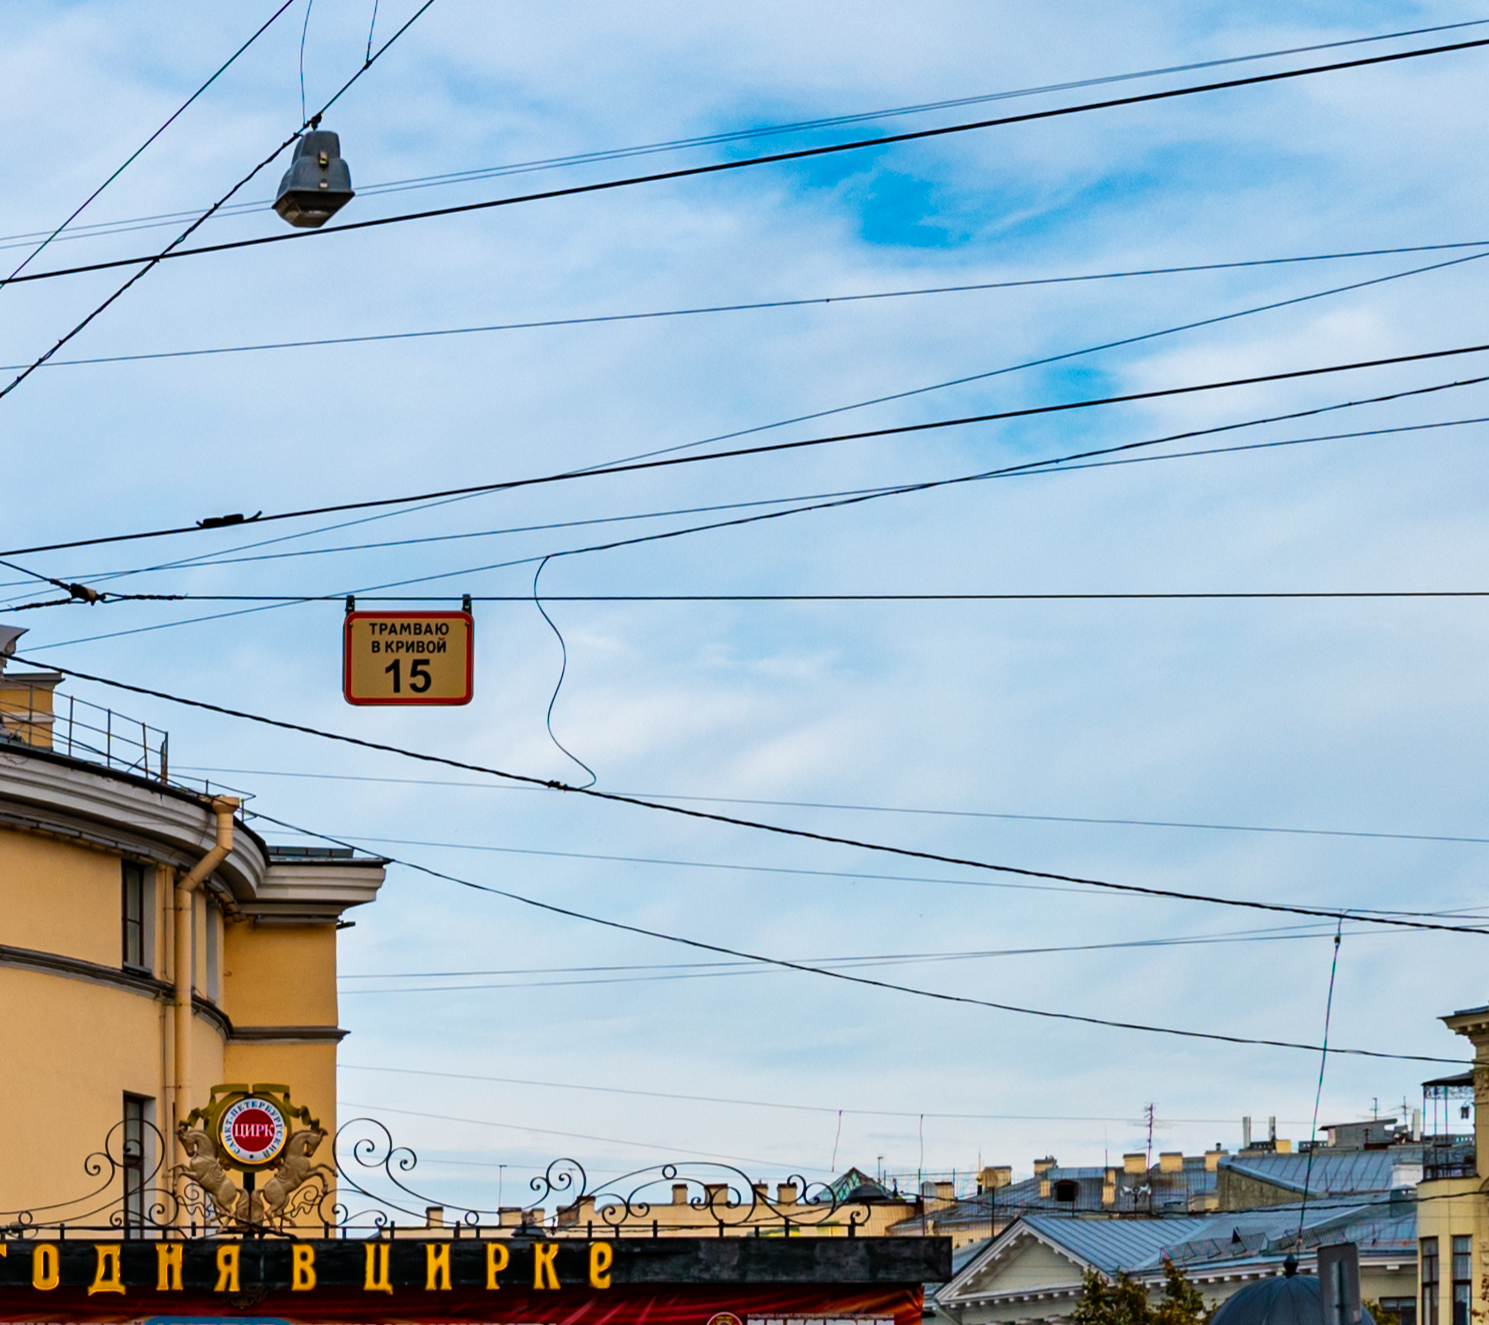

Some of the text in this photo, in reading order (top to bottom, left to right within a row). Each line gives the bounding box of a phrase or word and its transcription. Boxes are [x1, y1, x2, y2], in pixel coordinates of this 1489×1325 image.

[369, 623, 449, 636] ТРАМВАЮ
[371, 637, 446, 653] В КРИВОЙ
[384, 658, 432, 693] 15
[224, 1100, 283, 1159] САНКТ-ПЕТЕРБУРГСКИЙ
[234, 1123, 275, 1139] ЦИРК
[291, 1243, 317, 1292] В
